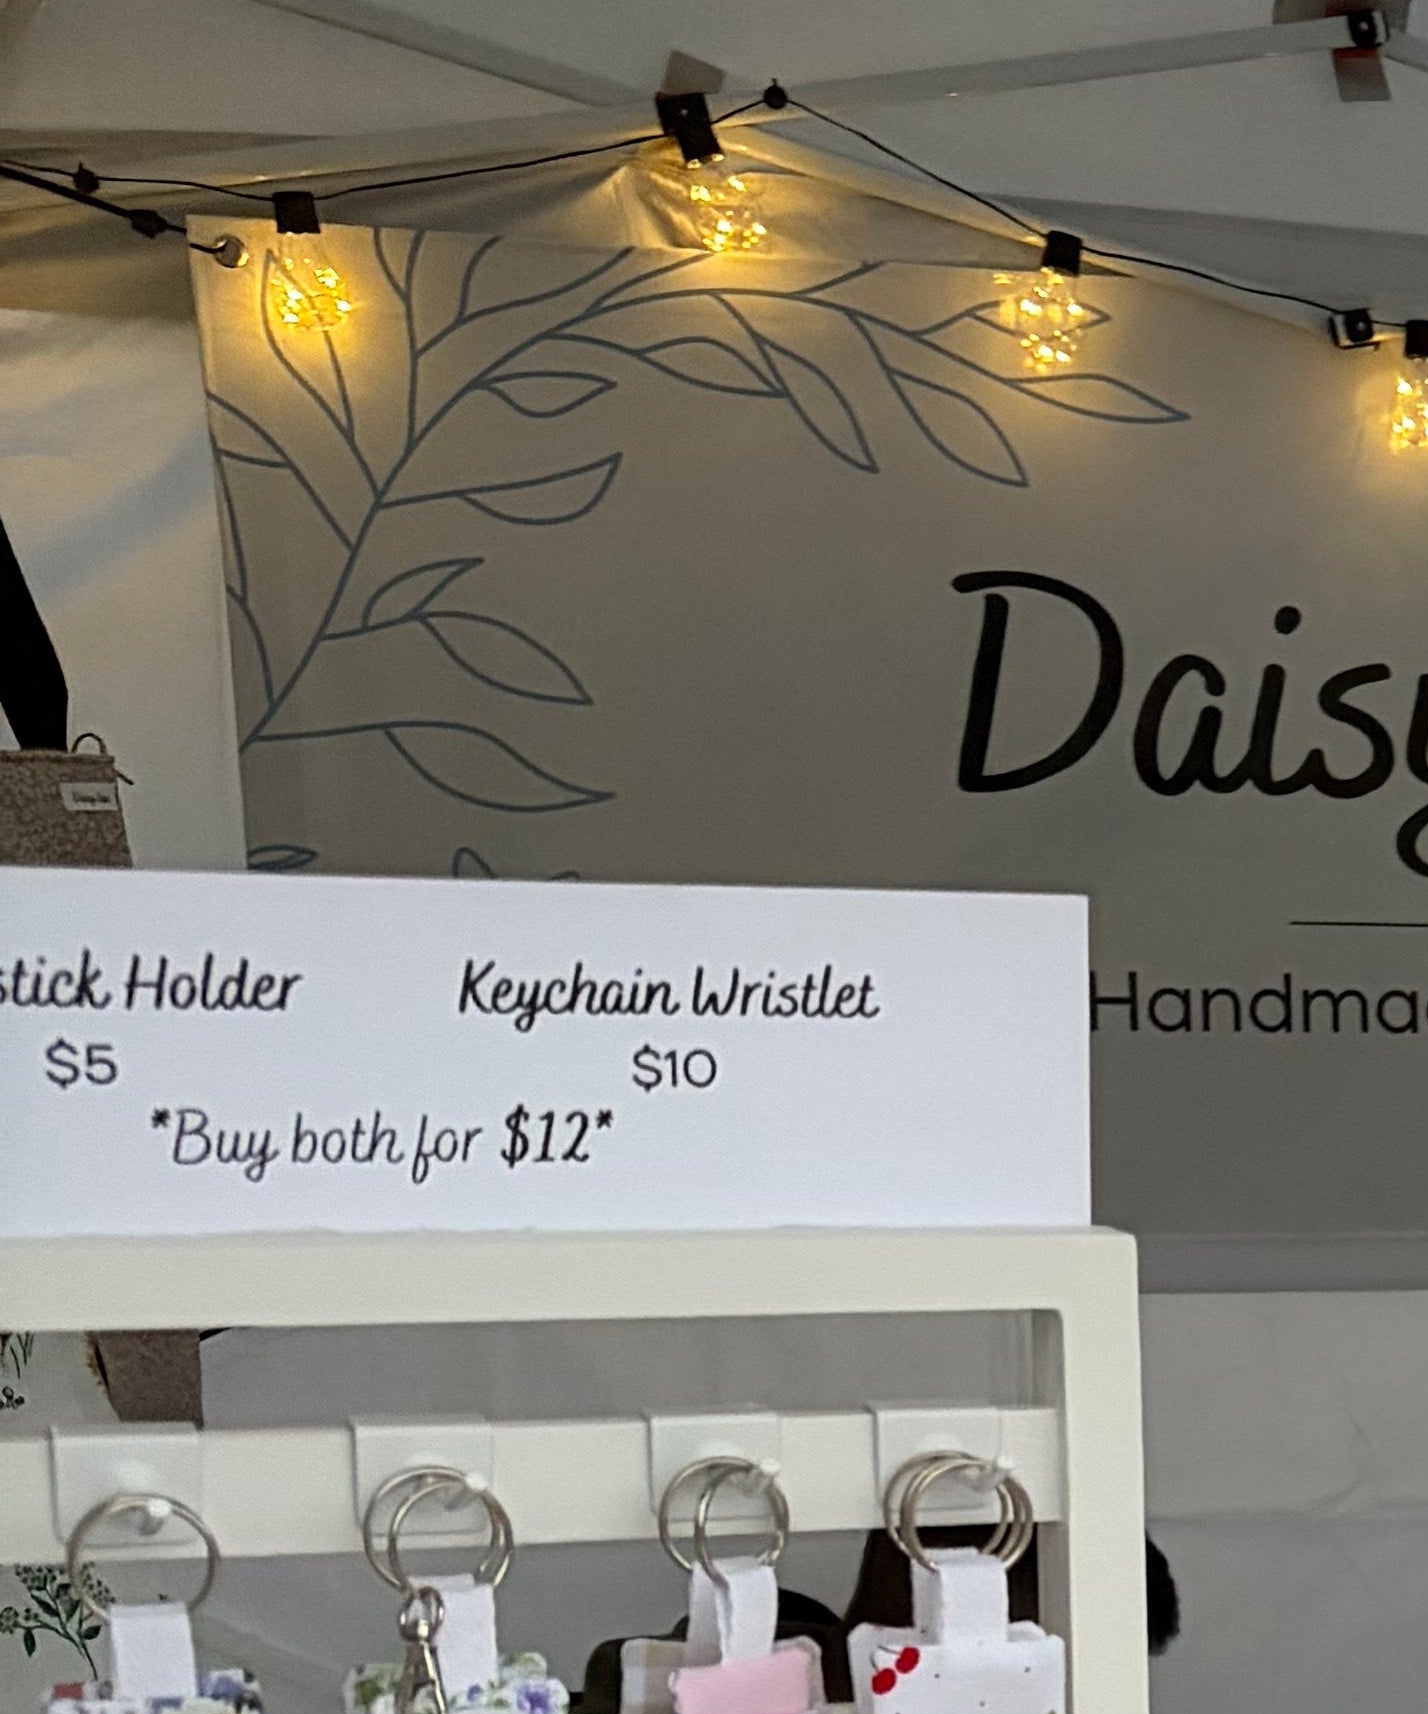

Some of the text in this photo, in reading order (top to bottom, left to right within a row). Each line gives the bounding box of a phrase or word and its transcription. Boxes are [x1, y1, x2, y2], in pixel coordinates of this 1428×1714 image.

[125, 952, 303, 1011] Holder
[458, 958, 881, 1032] Keychain Wristlet
[45, 1036, 119, 1090] $5
[631, 1044, 718, 1092] $10
[291, 1111, 404, 1166] both
[404, 1111, 484, 1184] for
